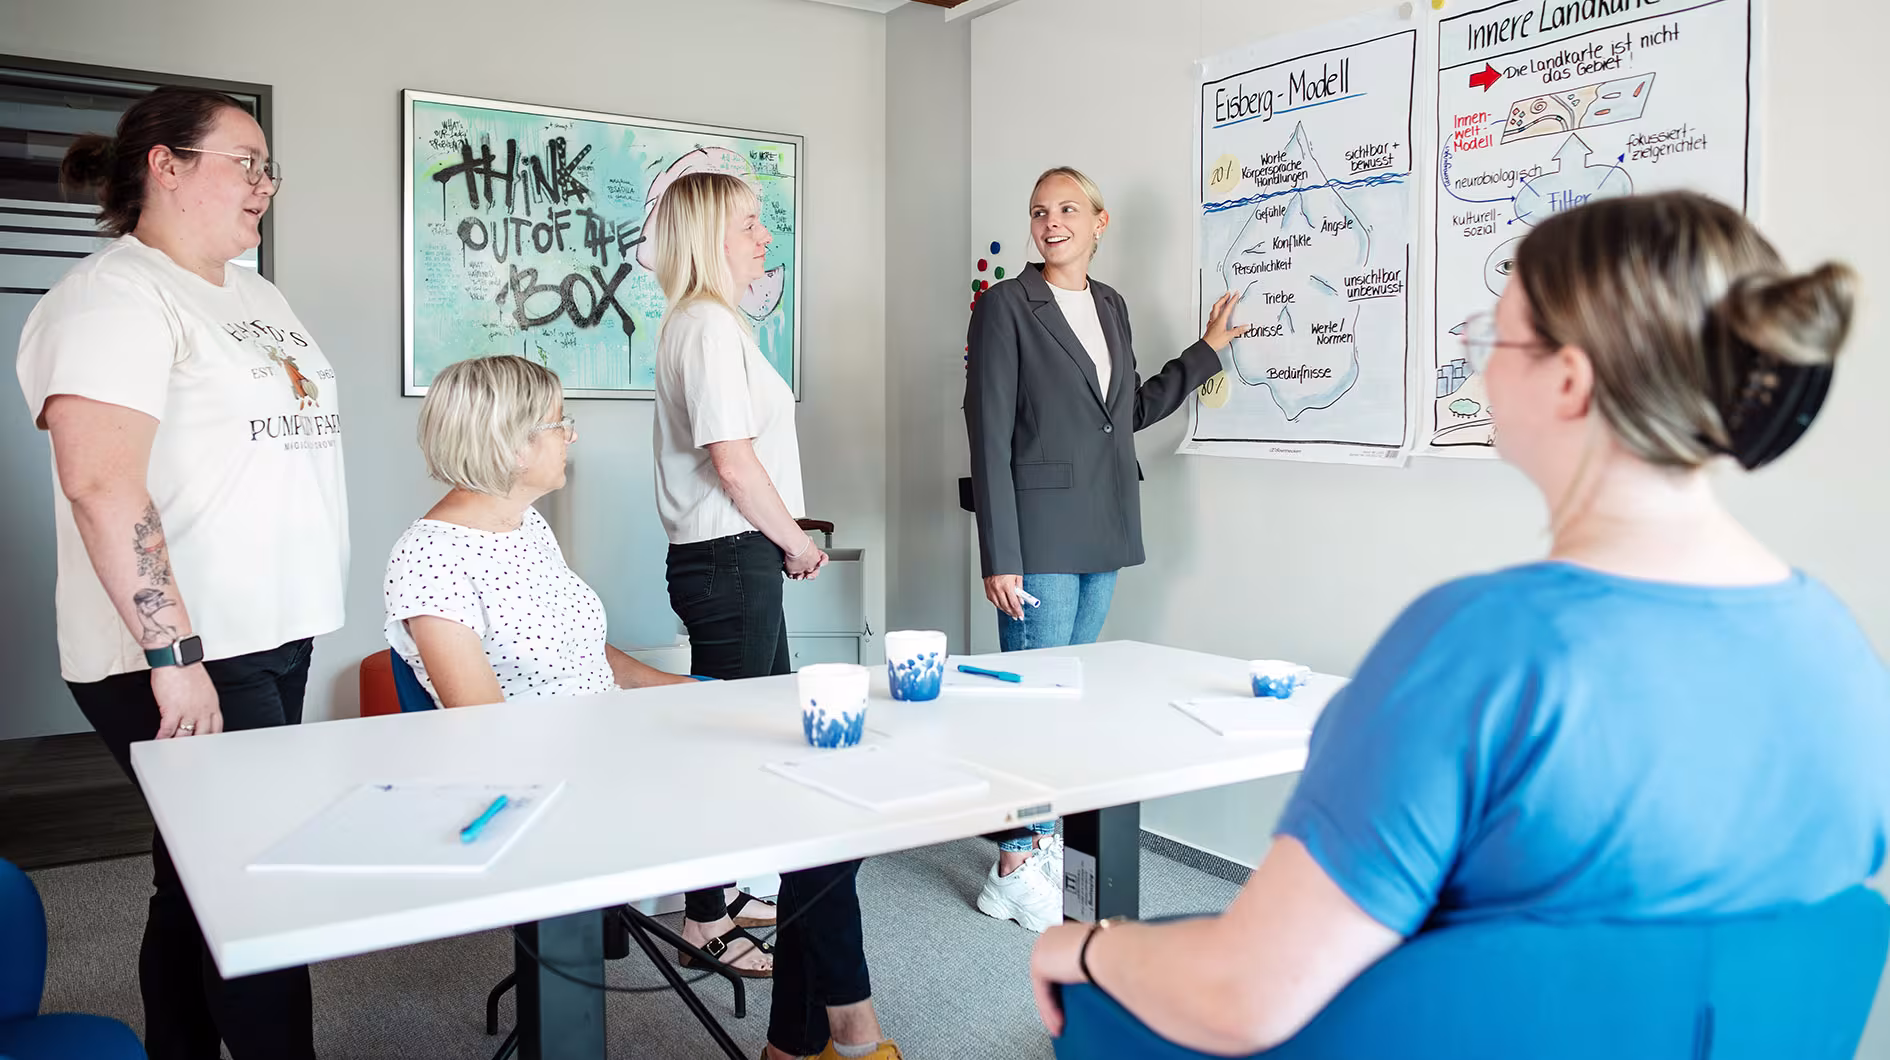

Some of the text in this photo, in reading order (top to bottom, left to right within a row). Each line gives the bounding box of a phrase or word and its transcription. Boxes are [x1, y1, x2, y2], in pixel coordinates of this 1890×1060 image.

[1468, 0, 1661, 51] Innere Landka
[1503, 22, 1680, 79] Die Landkarte ist nicht
[1543, 67, 1571, 84] das
[1454, 111, 1492, 129] Innen-
[1345, 143, 1389, 161] sichtbar
[1454, 134, 1493, 152] Modell
[1260, 150, 1287, 166] Worte
[1351, 155, 1395, 172] bewusst
[1242, 160, 1302, 183] Körpersprache
[1256, 170, 1309, 188] Handlungen
[1455, 164, 1543, 189] neurobiologisch
[1547, 189, 1592, 211] Filter
[1255, 205, 1286, 223] Gefühle
[1321, 215, 1354, 236] Ängste
[1463, 222, 1496, 237] sozial
[576, 207, 646, 266] THE
[1272, 235, 1312, 252] Konflikte
[1232, 257, 1292, 276] Persönlichkeit
[1344, 268, 1401, 287] unsichtbar
[495, 262, 633, 330] BOX
[1263, 290, 1296, 305] Triebe
[1347, 280, 1404, 298] unbewusst
[1233, 323, 1283, 339] ebnisse
[1316, 332, 1354, 345] Normen
[1266, 364, 1332, 384] Bedürfnisse
